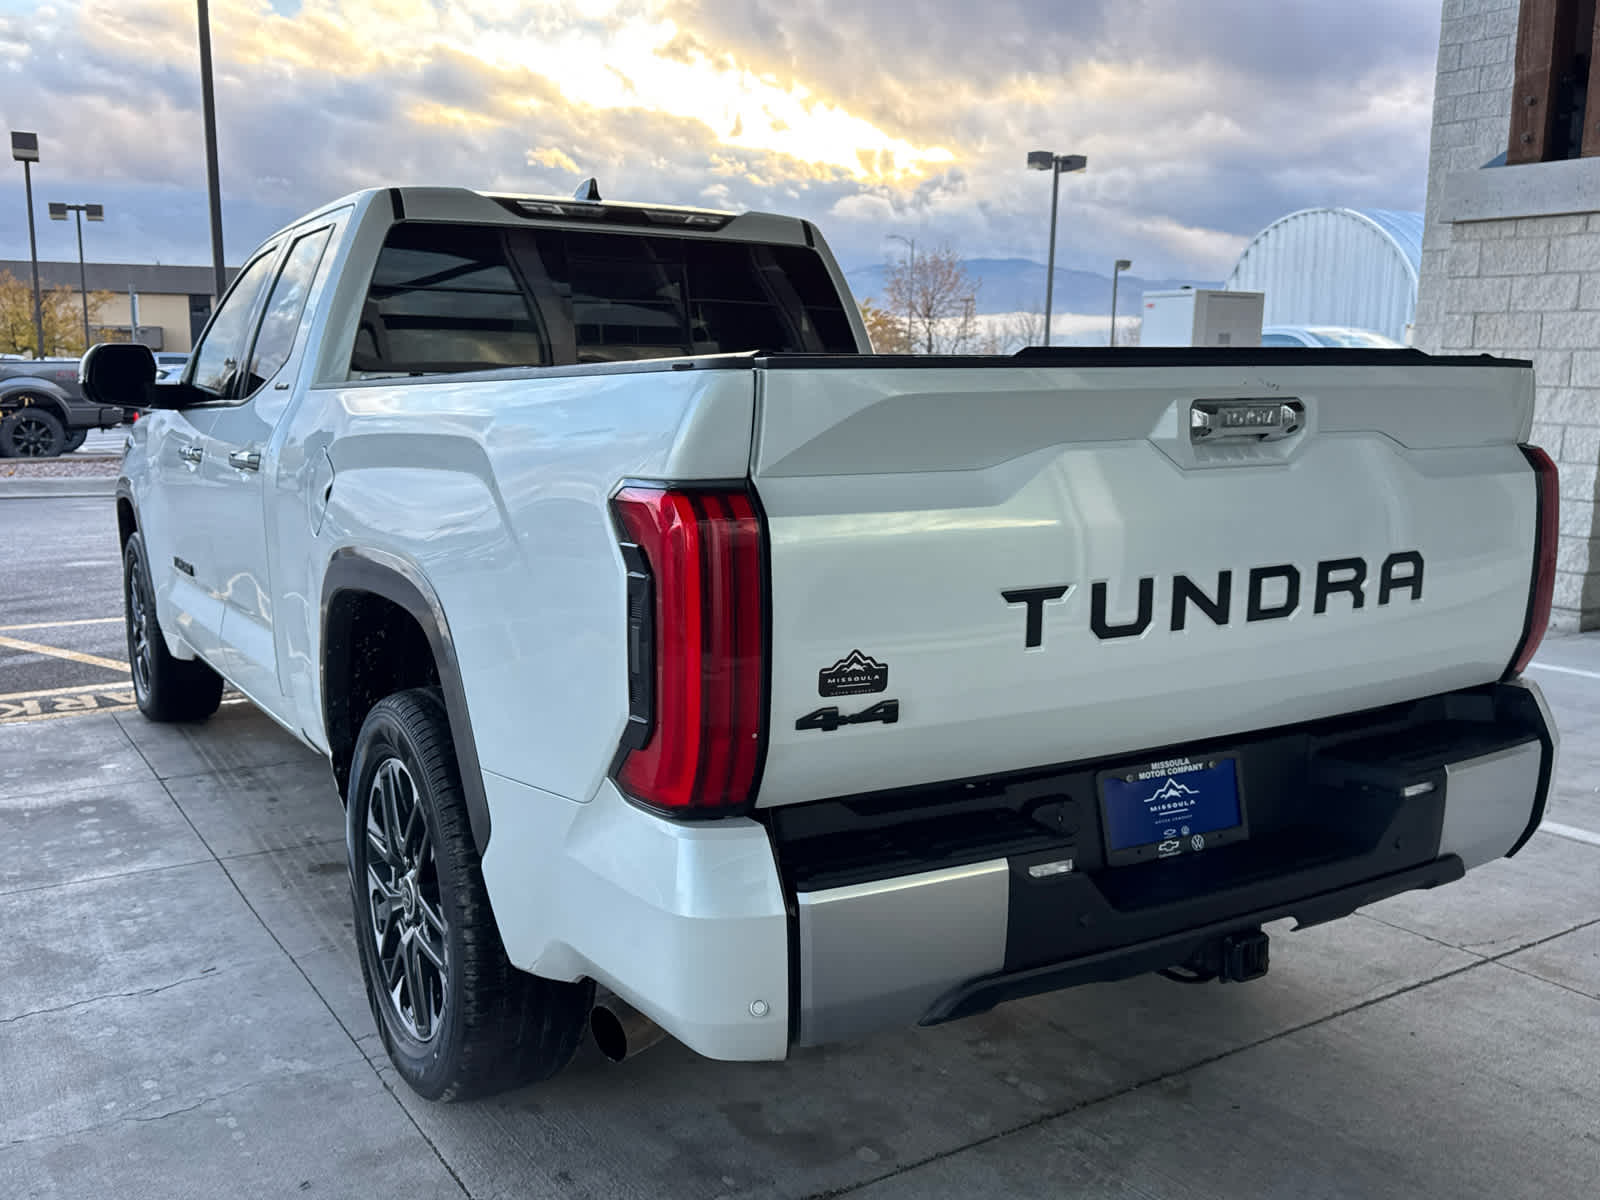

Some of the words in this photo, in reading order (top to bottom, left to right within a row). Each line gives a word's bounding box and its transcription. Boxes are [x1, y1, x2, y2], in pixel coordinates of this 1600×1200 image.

[1001, 550, 1424, 649] TUNDRA
[827, 674, 880, 684] MISSOULA
[1151, 757, 1190, 770] MISSOULA
[1138, 769, 1166, 780] MOTOR
[1167, 762, 1204, 776] COMPANY
[1150, 799, 1196, 812] MISSOULA
